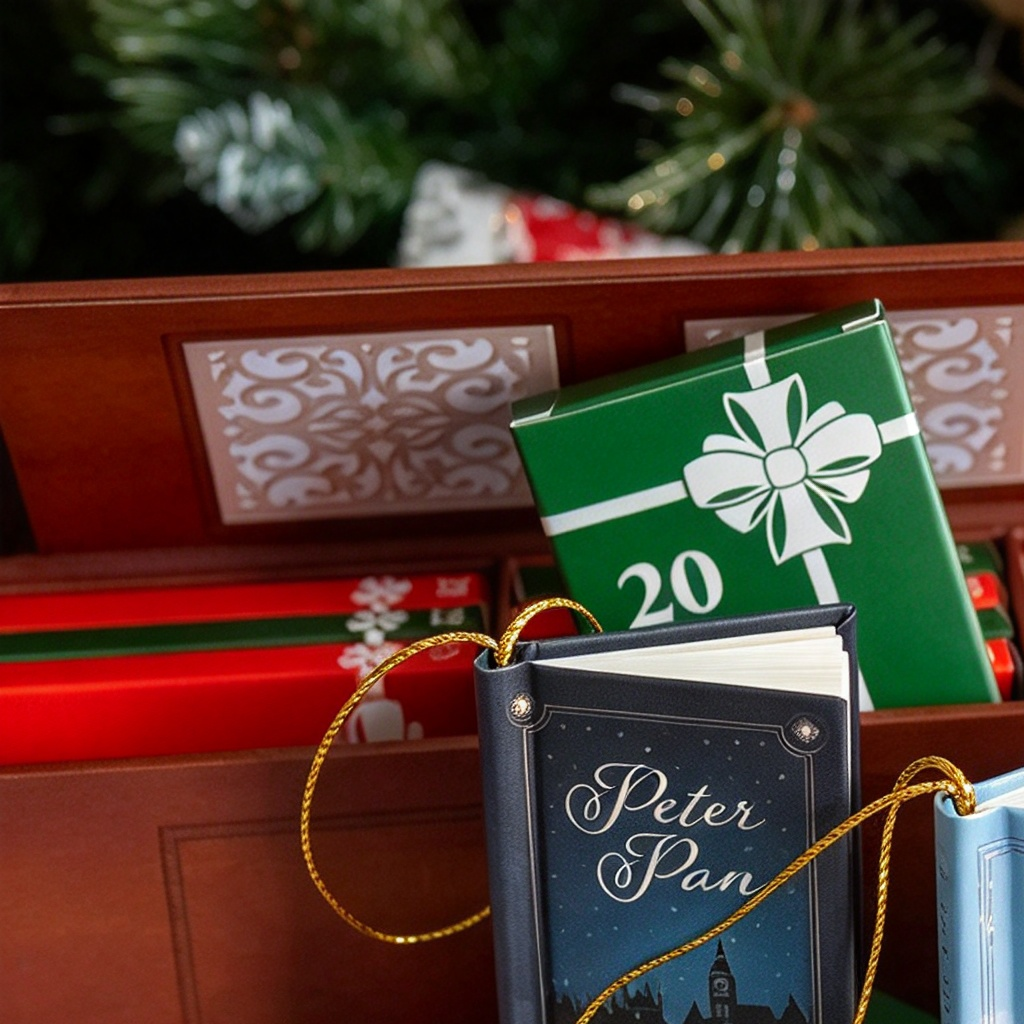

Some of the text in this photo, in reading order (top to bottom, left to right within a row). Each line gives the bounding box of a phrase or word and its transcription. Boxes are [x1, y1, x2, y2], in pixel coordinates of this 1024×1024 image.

[617, 550, 724, 630] 20
[565, 762, 766, 834] Peter
[597, 832, 768, 903] Pan
